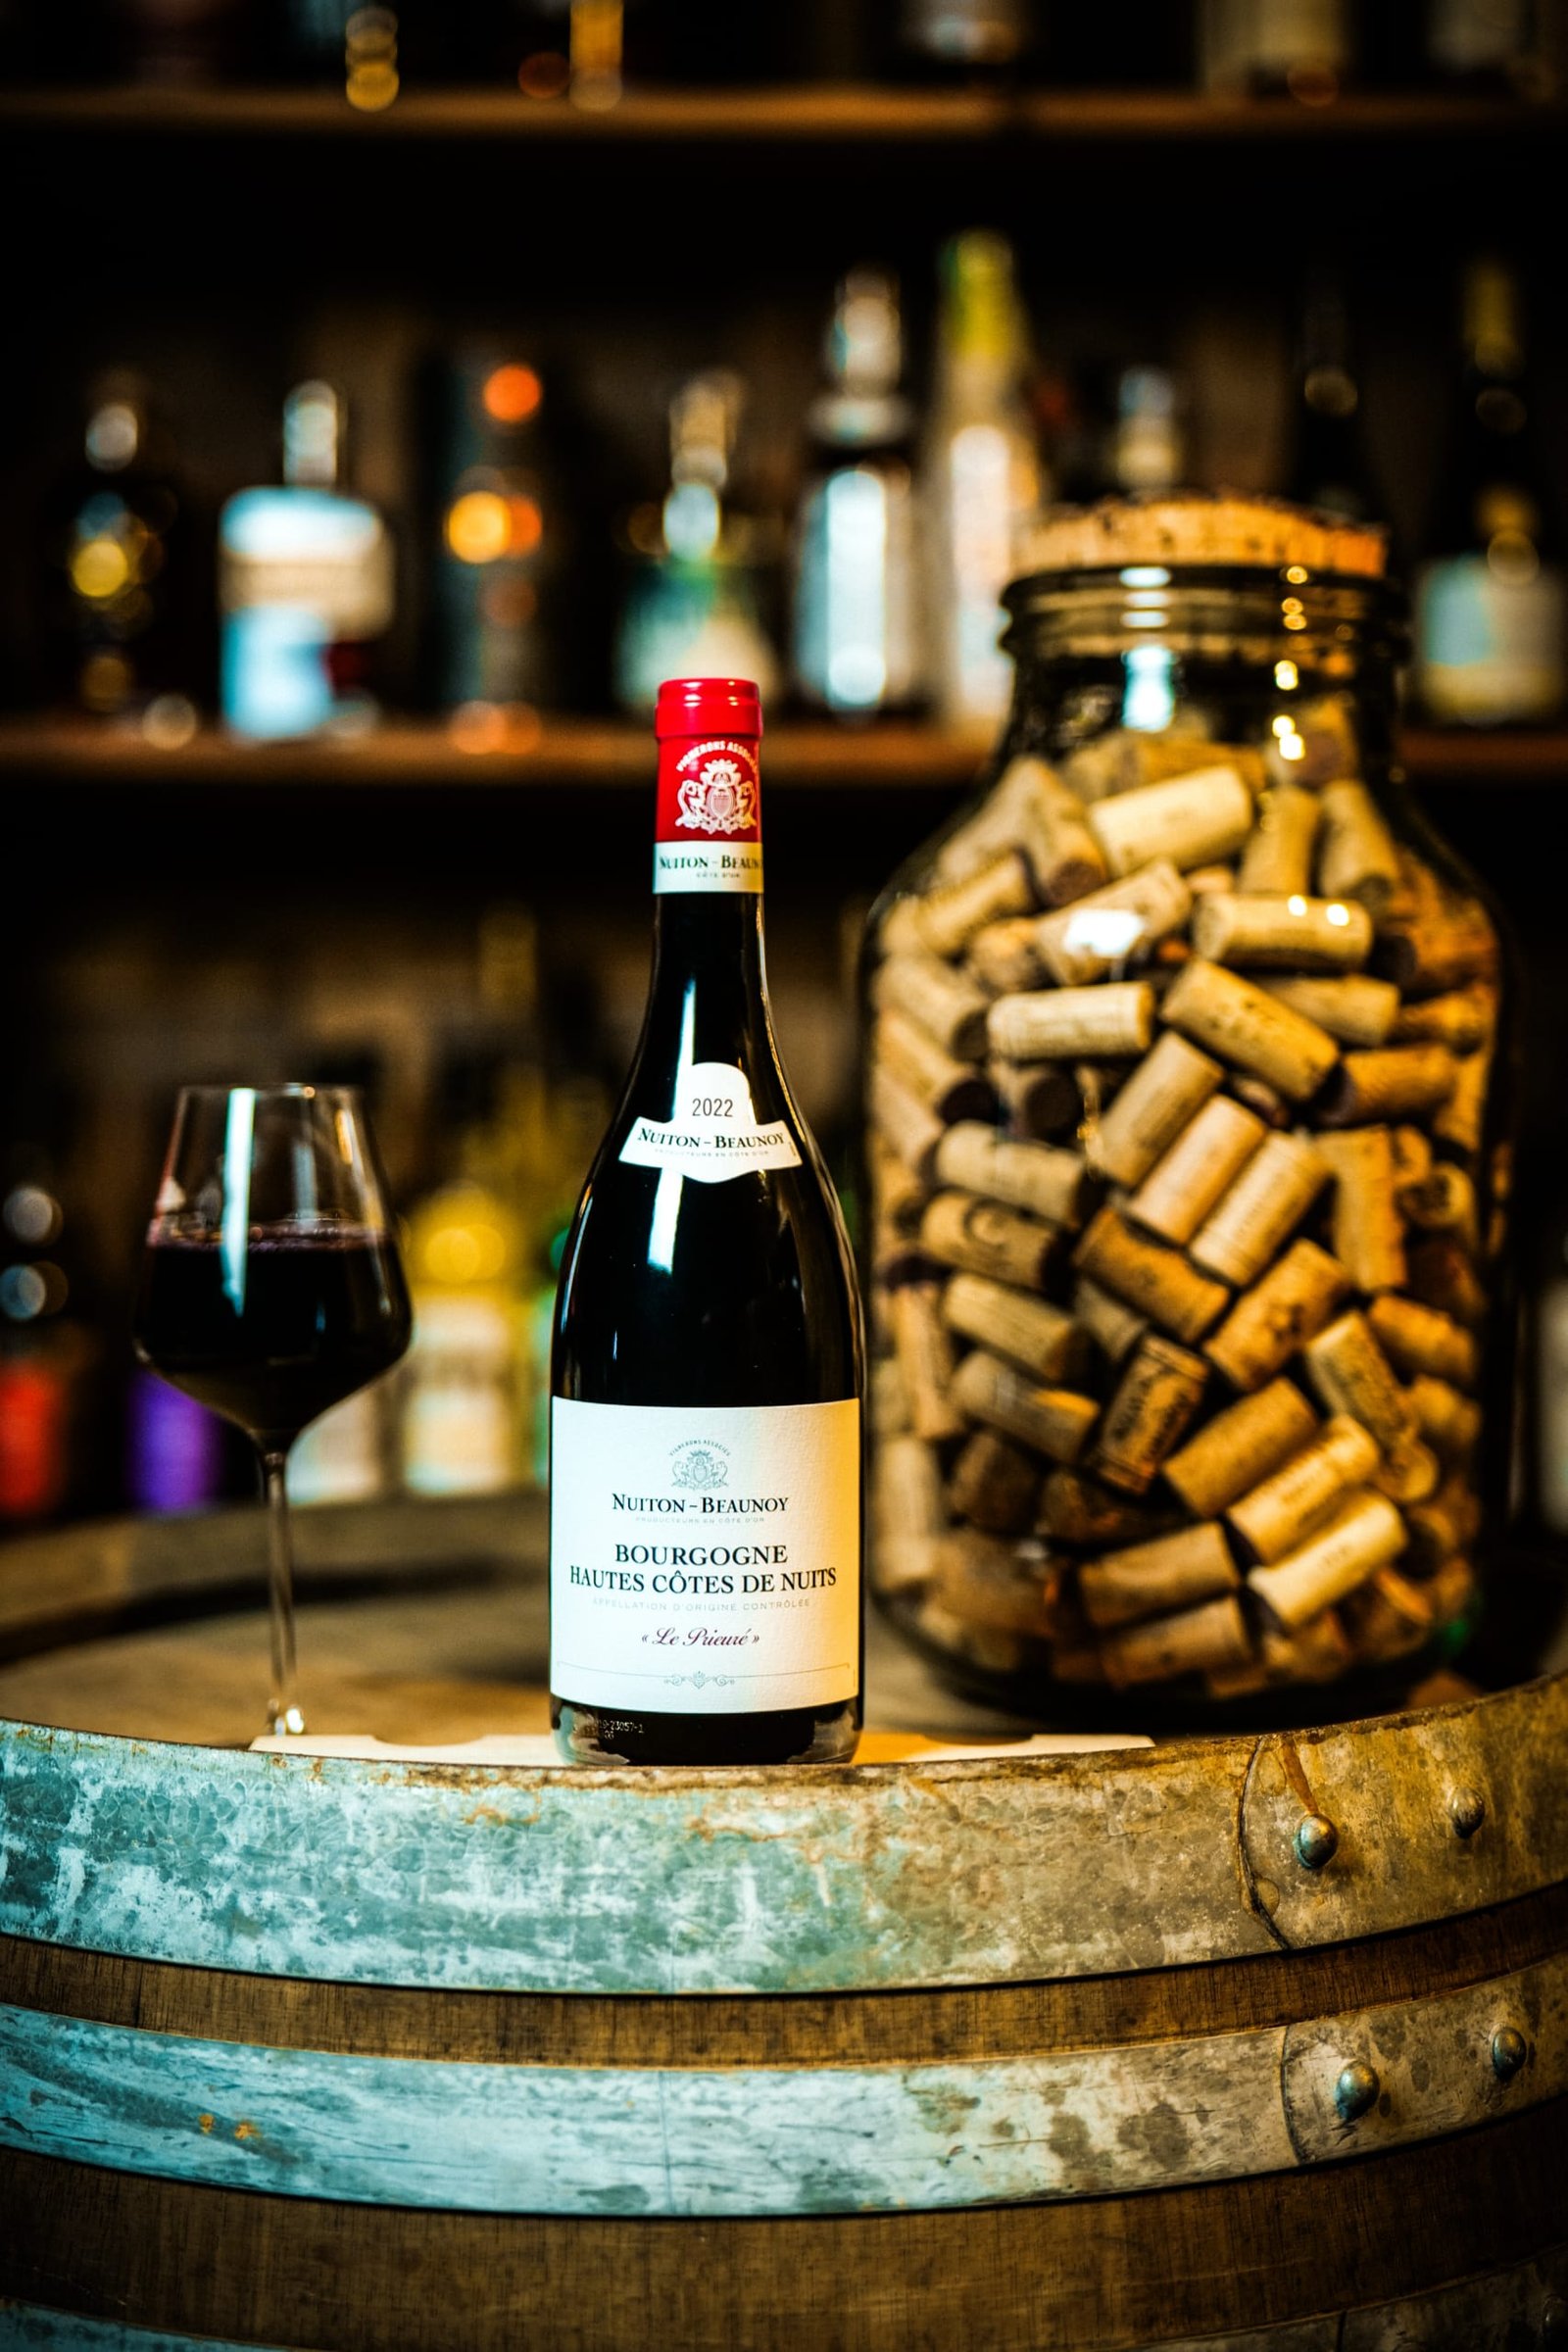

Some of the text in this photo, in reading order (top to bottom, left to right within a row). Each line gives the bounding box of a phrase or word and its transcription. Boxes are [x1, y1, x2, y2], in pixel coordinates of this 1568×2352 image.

[692, 1098, 734, 1117] 2022
[615, 1544, 788, 1566] BOURGOGNE
[570, 1565, 837, 1594] HAUTES CÔTES DE NUITS
[652, 1627, 680, 1646] Le
[682, 1627, 752, 1646] Prieuré
